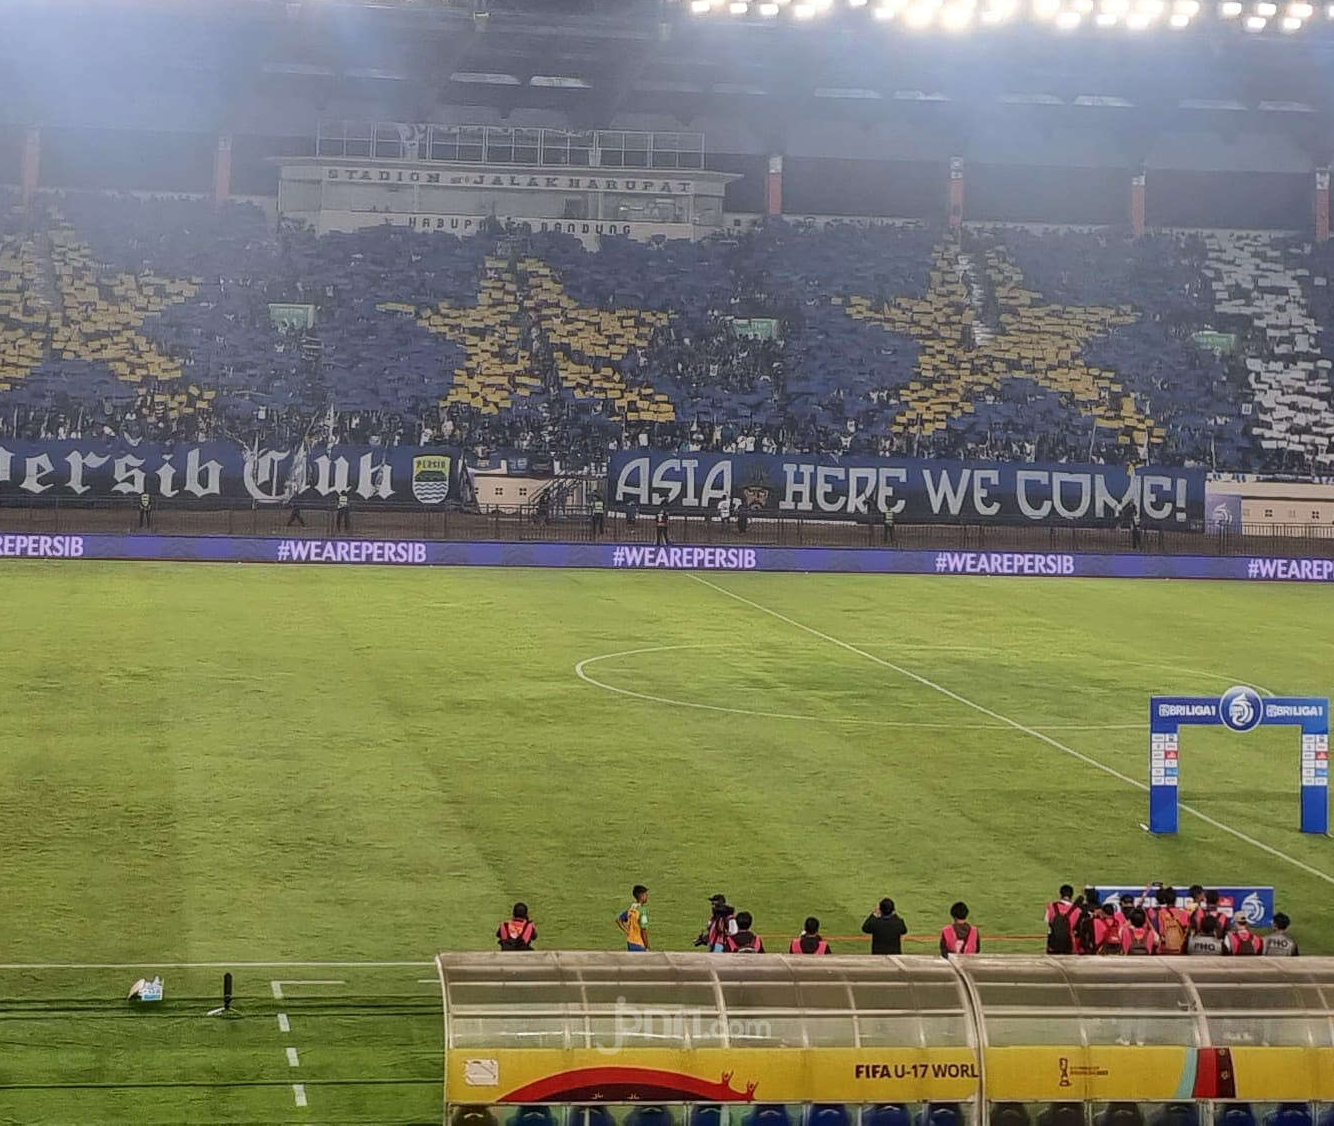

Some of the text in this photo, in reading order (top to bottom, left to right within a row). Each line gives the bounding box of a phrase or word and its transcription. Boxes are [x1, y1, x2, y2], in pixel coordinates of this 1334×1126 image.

[327, 169, 440, 183] STADION
[473, 175, 558, 187] JALAK
[569, 177, 691, 192] HARUPAT
[244, 443, 395, 503] Club
[616, 457, 1187, 522] ASIA HERE WE COME!
[278, 540, 426, 562] #WEAREPERSIB
[613, 546, 756, 569] #WEAREPERSIB
[935, 551, 1074, 574] #WEAREPERSIB
[855, 1064, 891, 1078] FIFA
[894, 1064, 928, 1078] U-17
